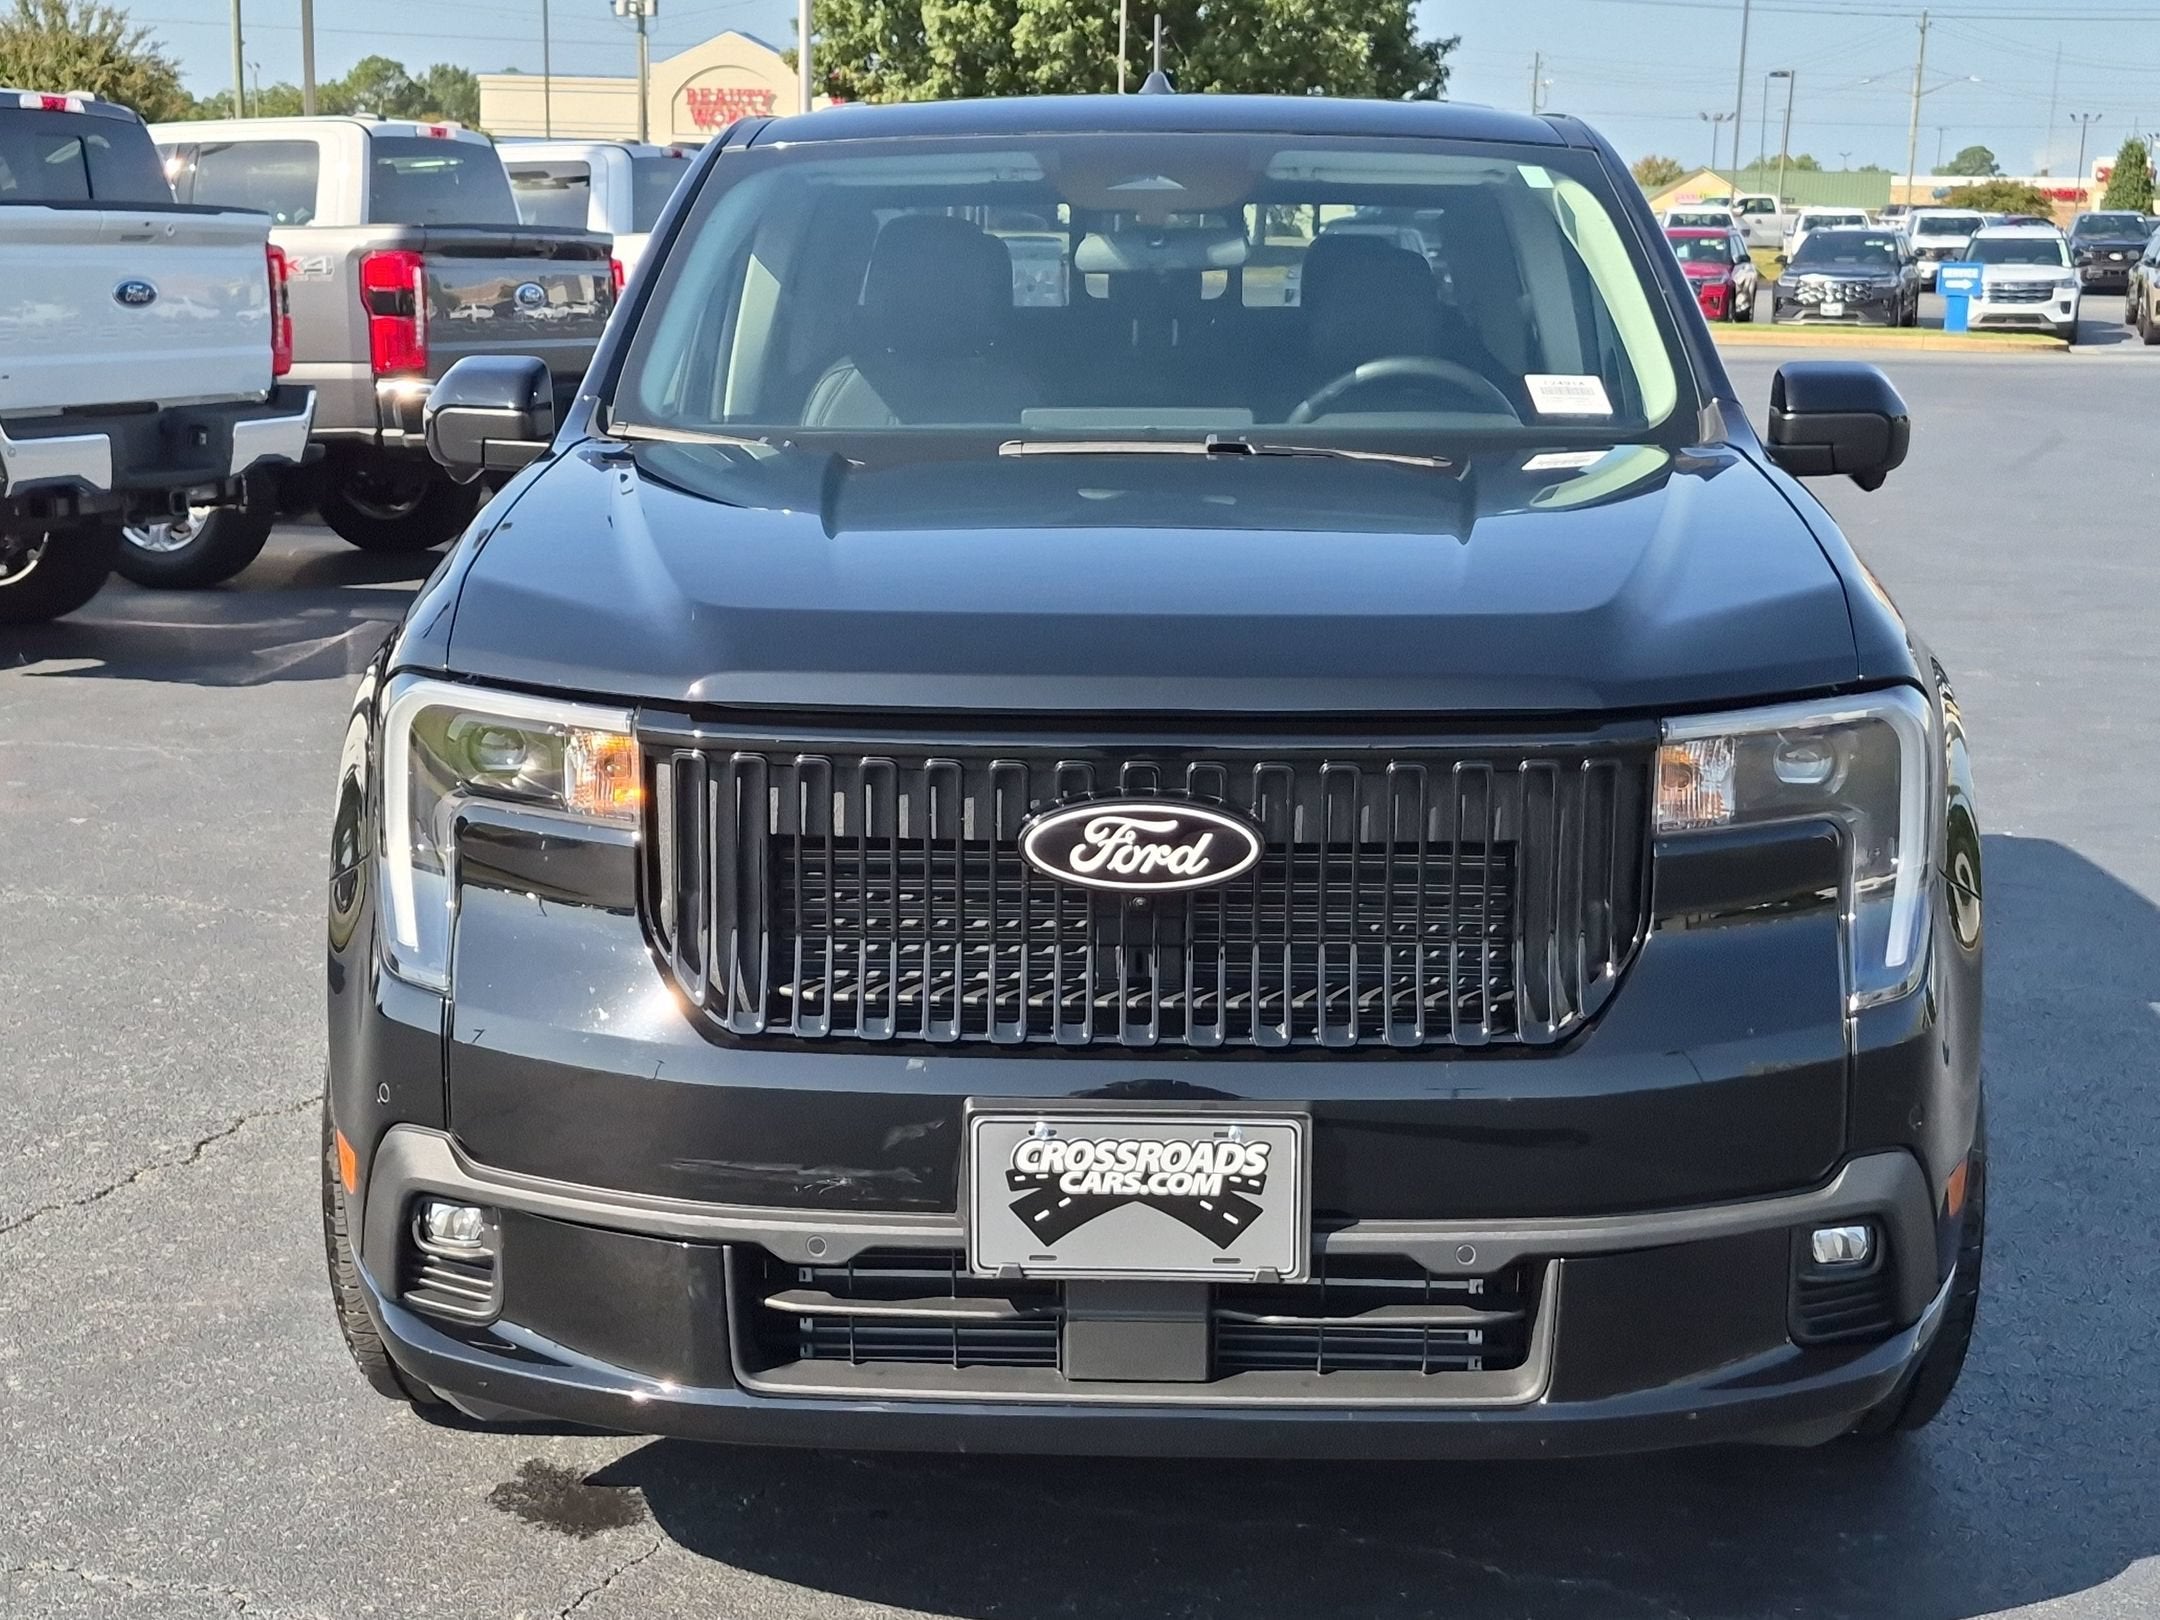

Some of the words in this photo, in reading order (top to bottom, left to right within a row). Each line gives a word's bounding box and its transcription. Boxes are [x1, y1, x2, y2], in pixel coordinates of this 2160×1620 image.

[686, 87, 775, 106] BEAUTY
[125, 284, 150, 302] Ford
[1069, 815, 1214, 875] Ford
[1011, 1138, 1271, 1176] CROSSROADS
[1058, 1171, 1225, 1197] CARS.COM
